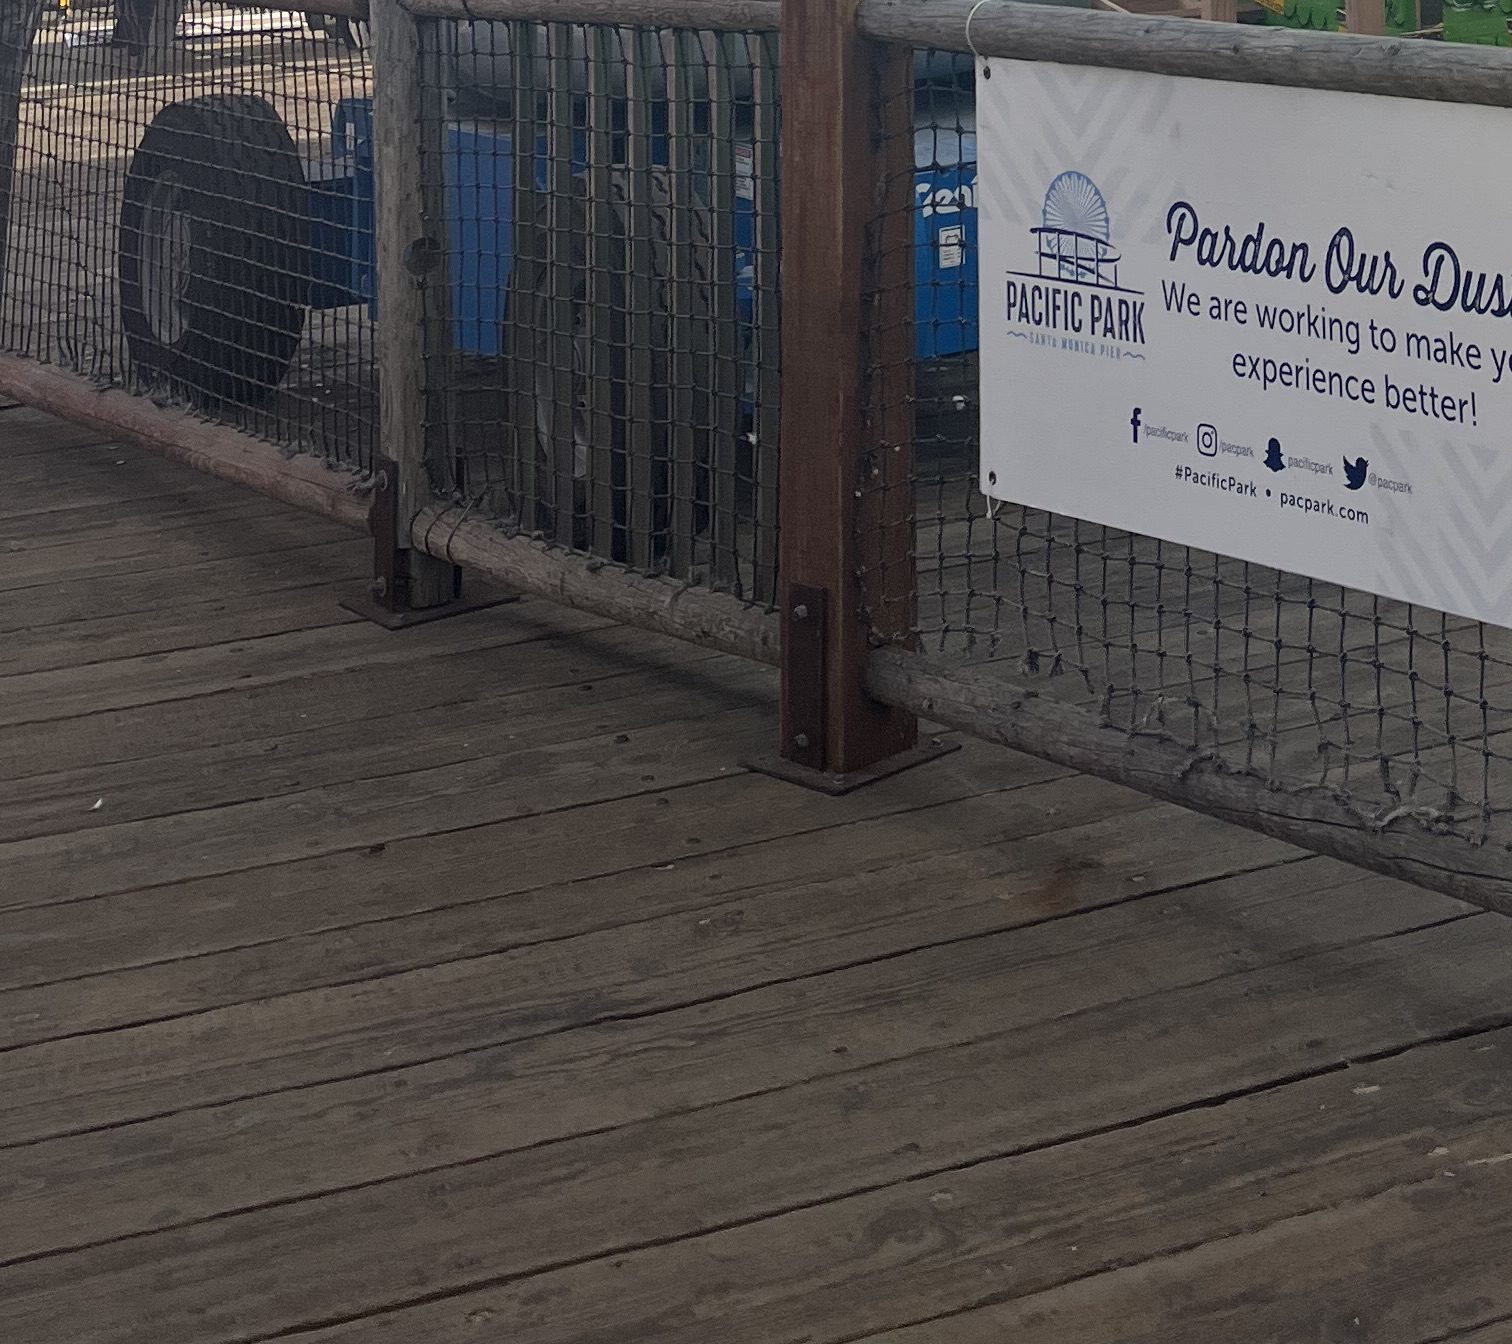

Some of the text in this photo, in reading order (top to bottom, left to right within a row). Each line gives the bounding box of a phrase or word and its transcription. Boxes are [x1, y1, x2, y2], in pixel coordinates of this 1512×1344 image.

[1166, 201, 1316, 282] Pardon
[1325, 227, 1405, 299] Our
[1006, 280, 1146, 345] PACIFIC PARK
[1161, 279, 1201, 317] We
[1208, 296, 1248, 325] are
[1255, 303, 1360, 355] working
[1368, 318, 1397, 353] to
[1406, 331, 1482, 370] make
[1232, 353, 1478, 426] experience better!
[1174, 464, 1369, 524] #PacificPark pacpark.com
[1287, 456, 1334, 476] pacificpark
[1368, 472, 1414, 494] @pacpark
